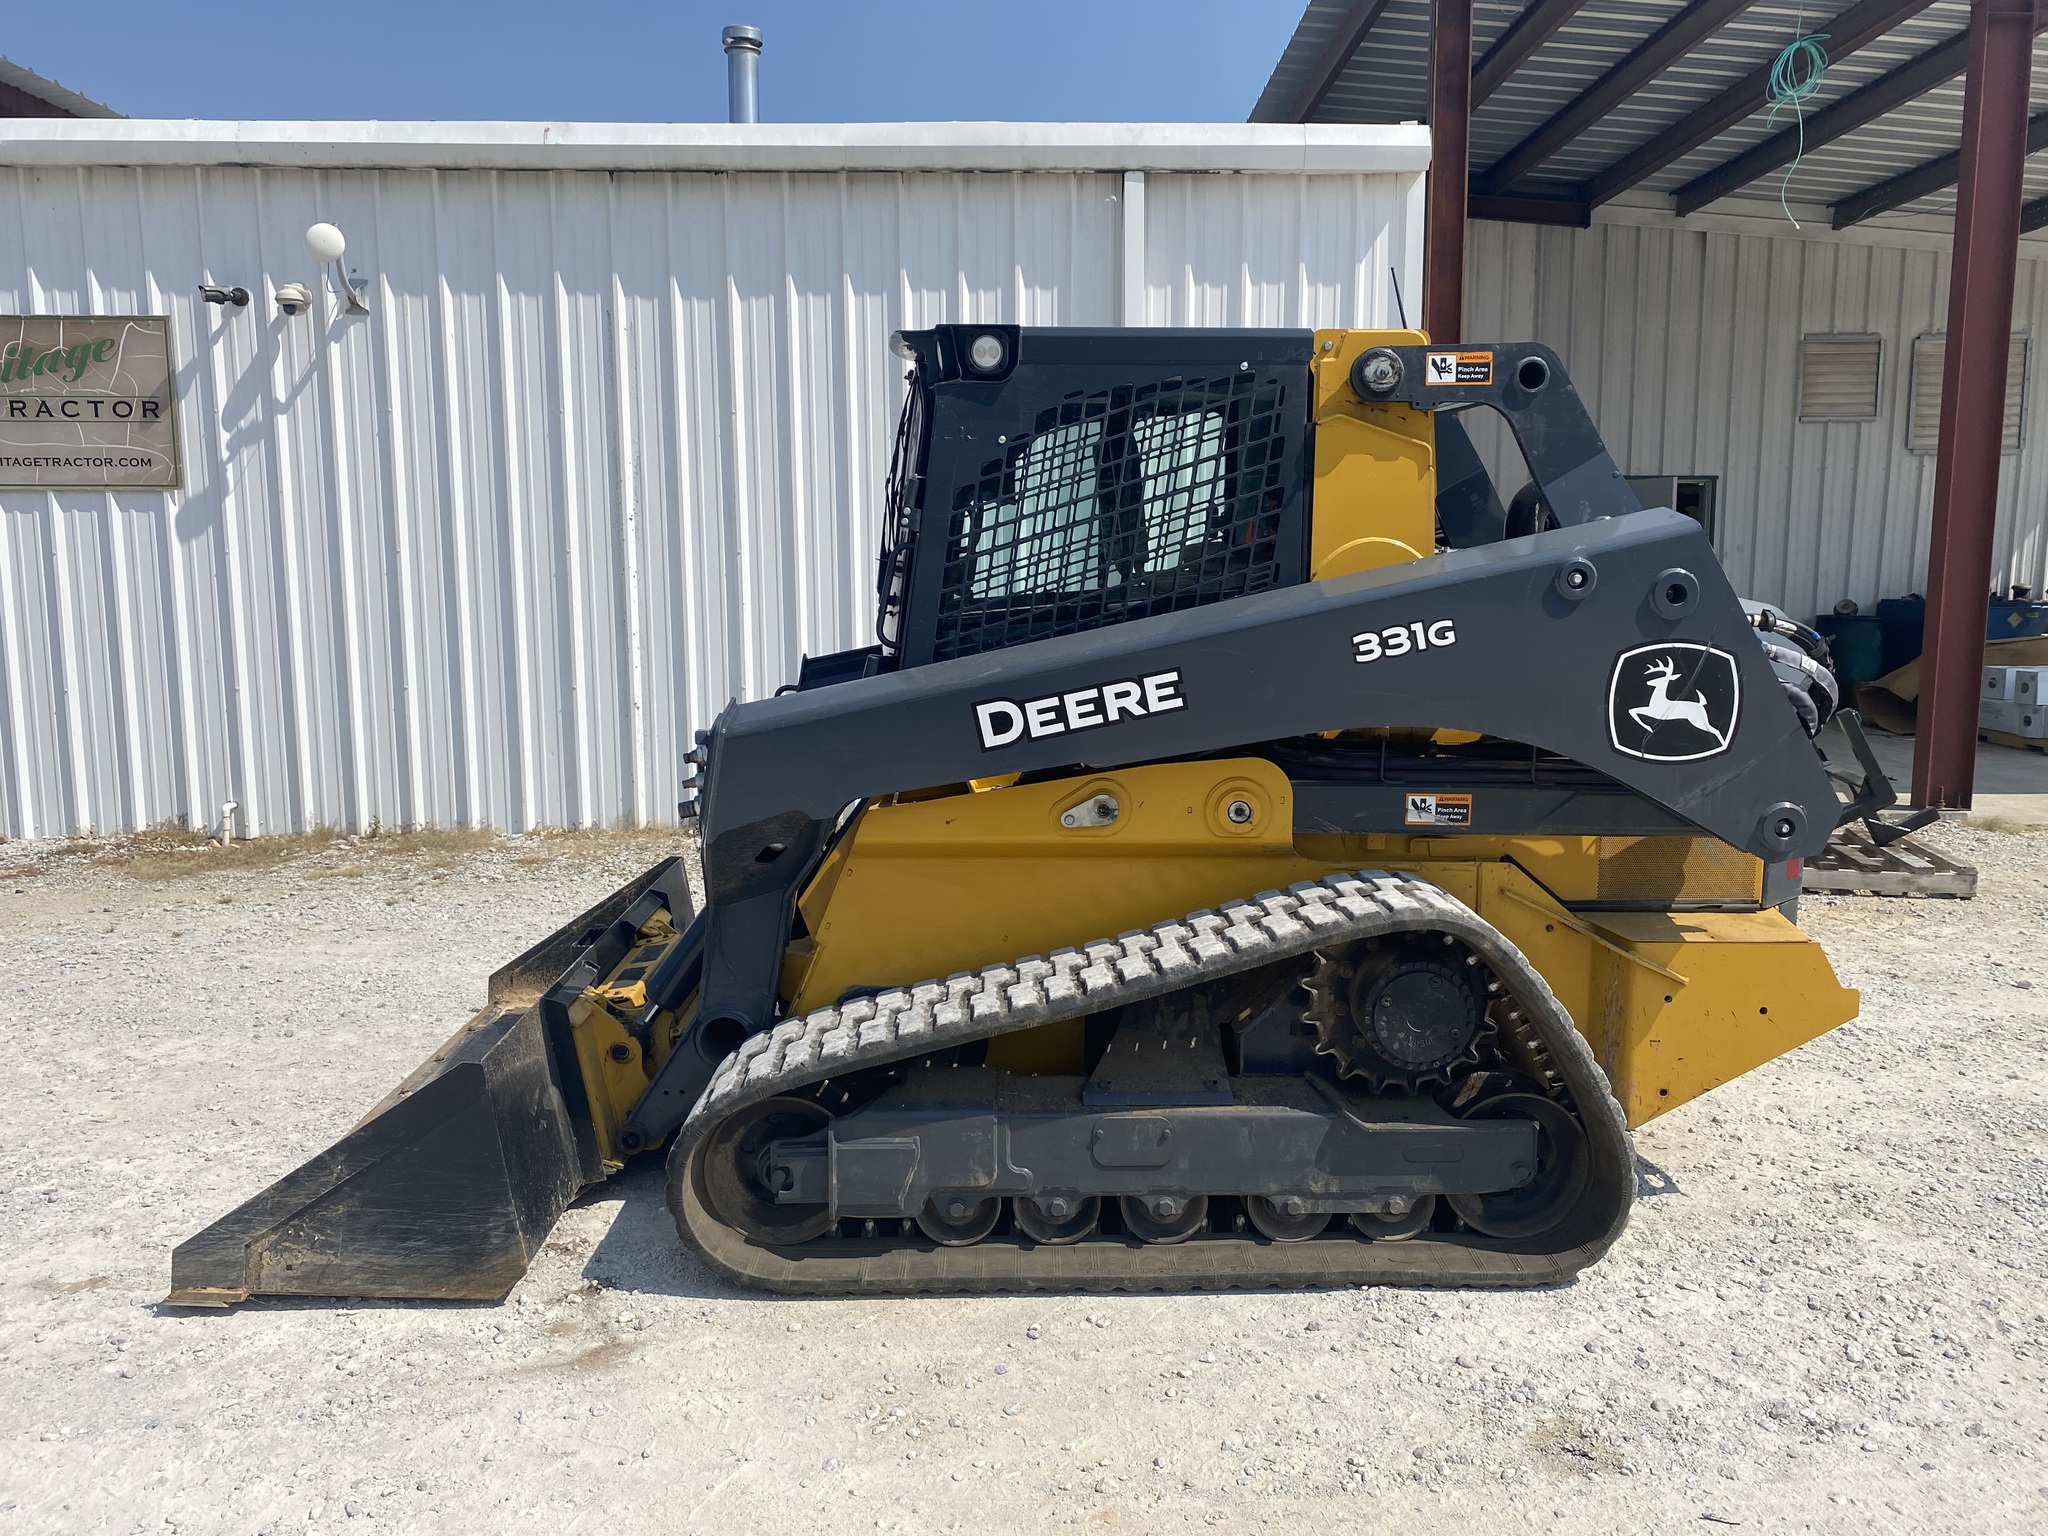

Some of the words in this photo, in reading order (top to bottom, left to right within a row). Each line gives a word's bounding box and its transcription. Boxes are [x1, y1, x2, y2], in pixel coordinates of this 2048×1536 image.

[0, 400, 160, 418] RACTOR
[0, 457, 152, 467] ITAGETRACTOR.COM
[1352, 620, 1456, 662] 331G
[975, 671, 1184, 748] DEERE
